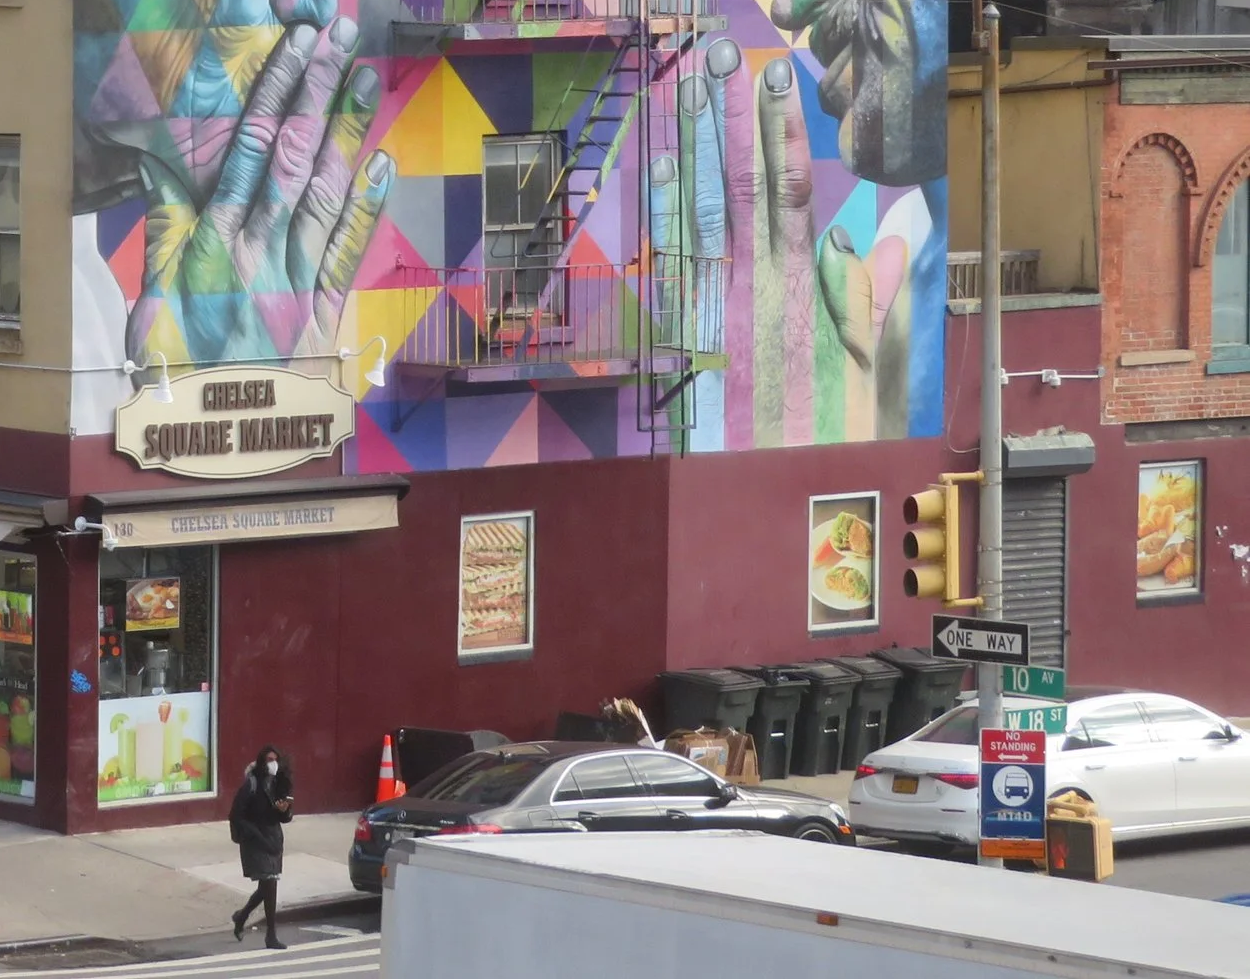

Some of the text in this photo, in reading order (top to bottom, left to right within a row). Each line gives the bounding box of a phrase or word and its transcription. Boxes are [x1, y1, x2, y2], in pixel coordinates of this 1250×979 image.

[203, 379, 276, 411] CHELSEA
[144, 414, 334, 462] SQUARE MARKET
[113, 506, 335, 537] 130 CHELSEA SQUARE MARKET
[946, 629, 1016, 652] ONE WAY
[1012, 667, 1055, 692] 10 AV
[1008, 708, 1063, 731] W 18 ST
[990, 741, 1036, 752] STANDING
[1006, 732, 1020, 741] NO
